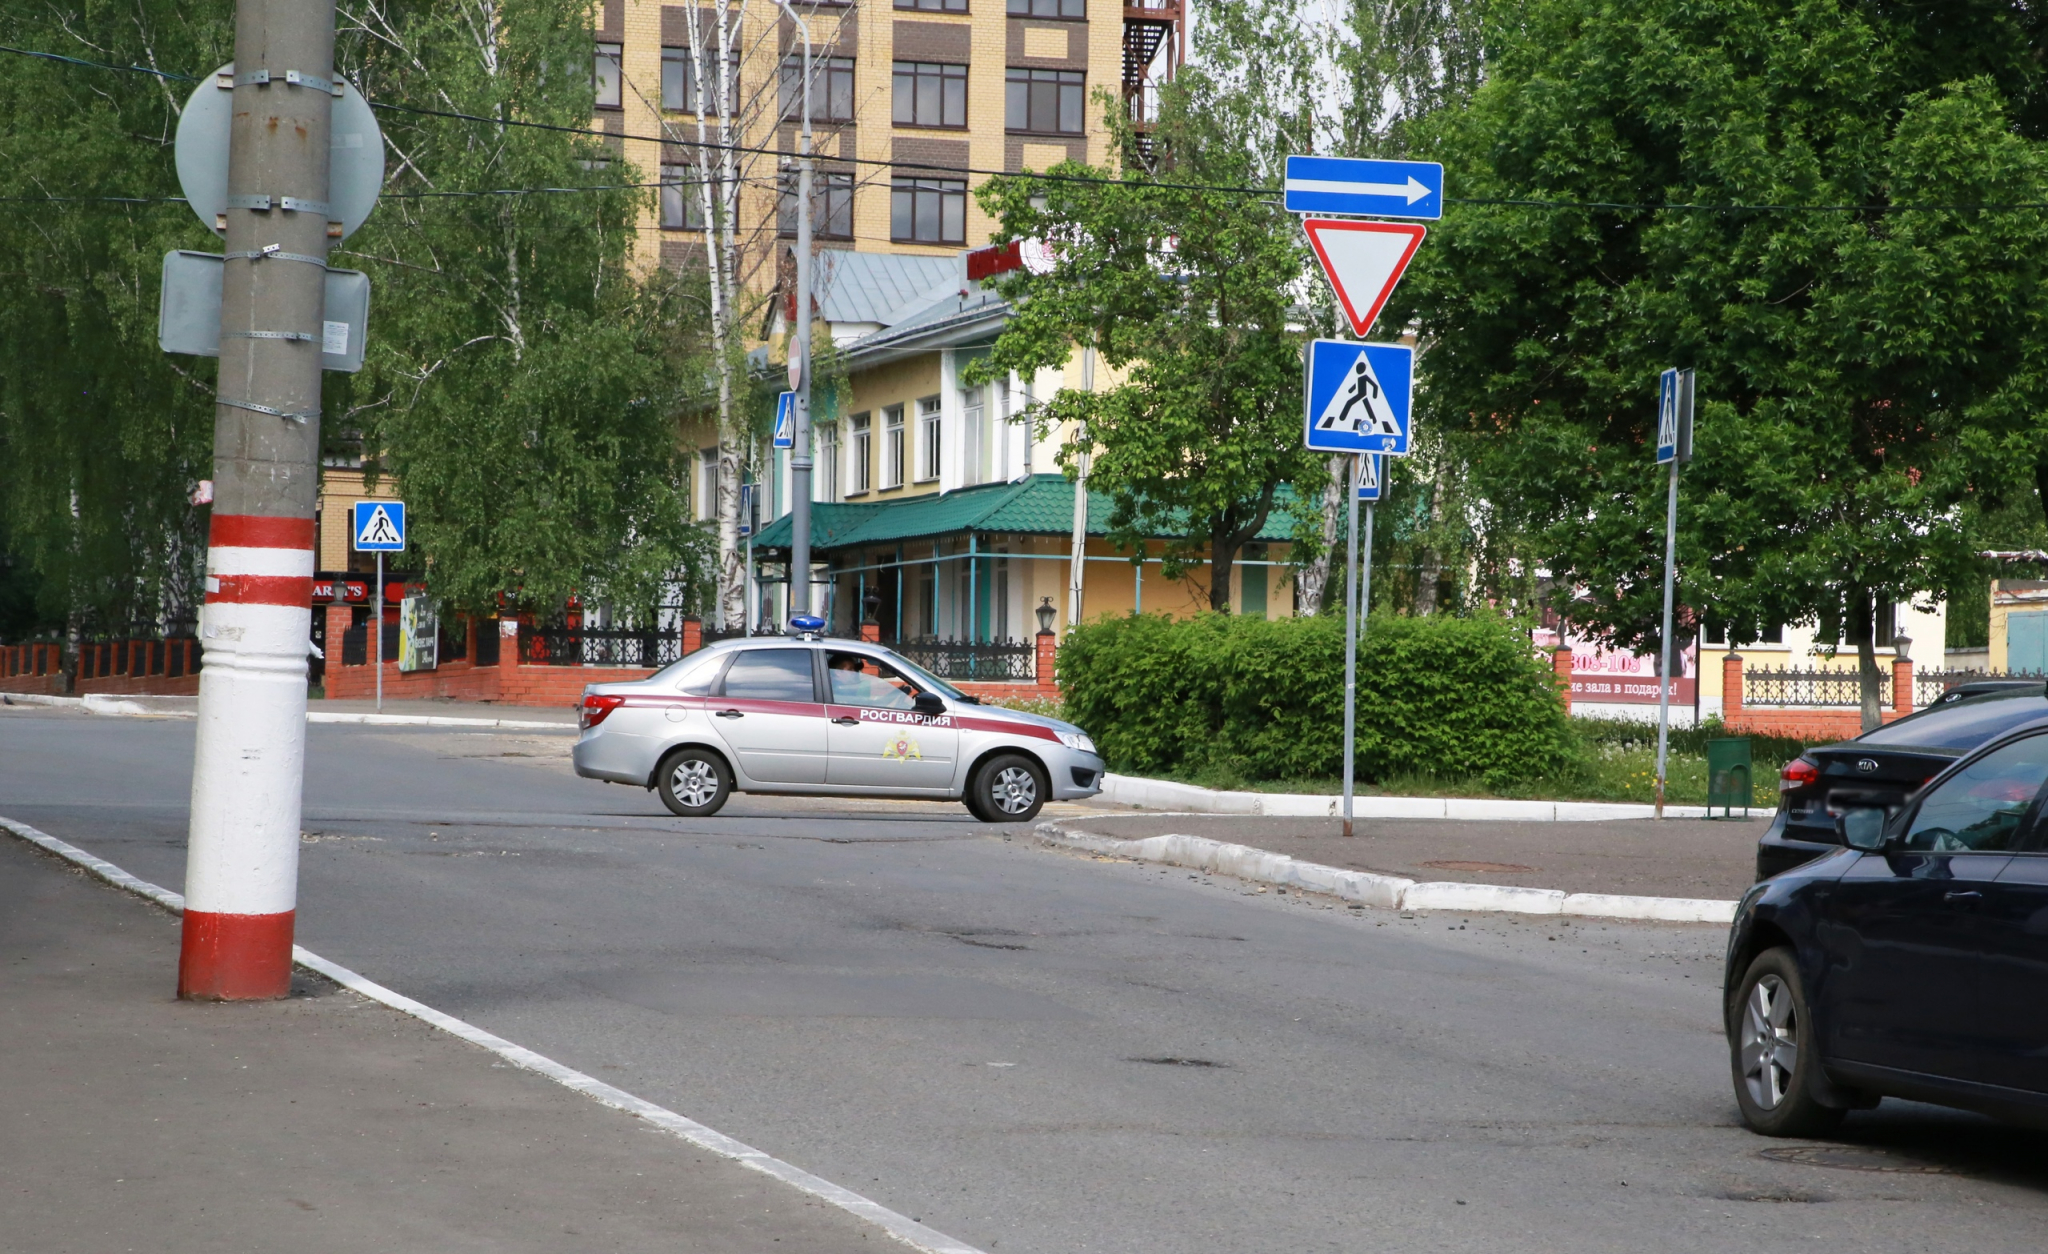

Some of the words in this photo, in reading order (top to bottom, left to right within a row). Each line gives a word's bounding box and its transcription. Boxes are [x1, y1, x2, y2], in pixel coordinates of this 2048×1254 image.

[1585, 682, 1612, 694] зала
[1614, 684, 1622, 694] в
[860, 709, 951, 727] РОСГВАРДИЯ
[1858, 761, 1873, 771] KIA
